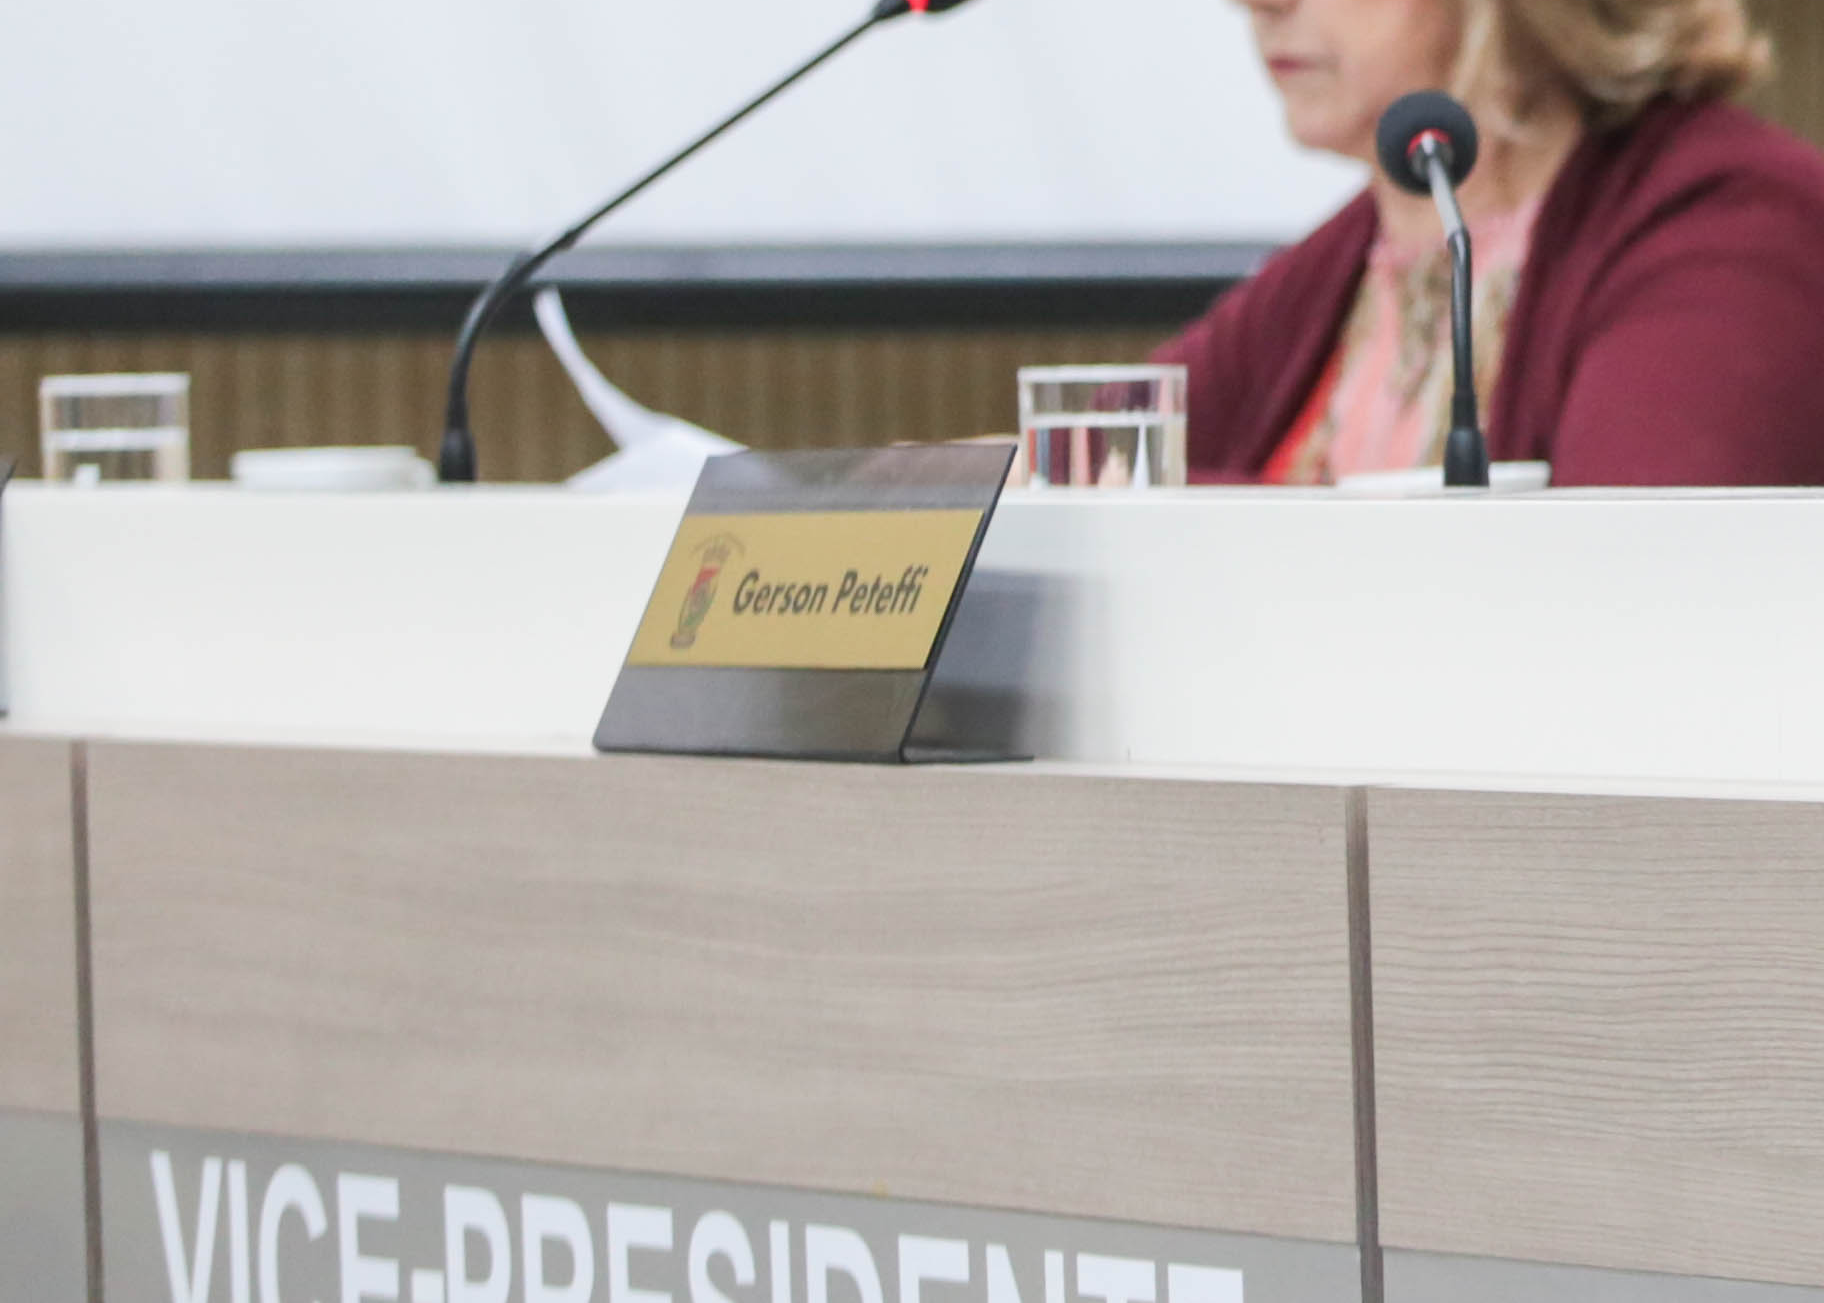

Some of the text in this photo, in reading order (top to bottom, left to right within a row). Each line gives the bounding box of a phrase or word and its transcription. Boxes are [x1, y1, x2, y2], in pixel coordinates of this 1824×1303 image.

[733, 564, 929, 615] Gerson Peteffi
[150, 1150, 1244, 1302] VICE-PRE
